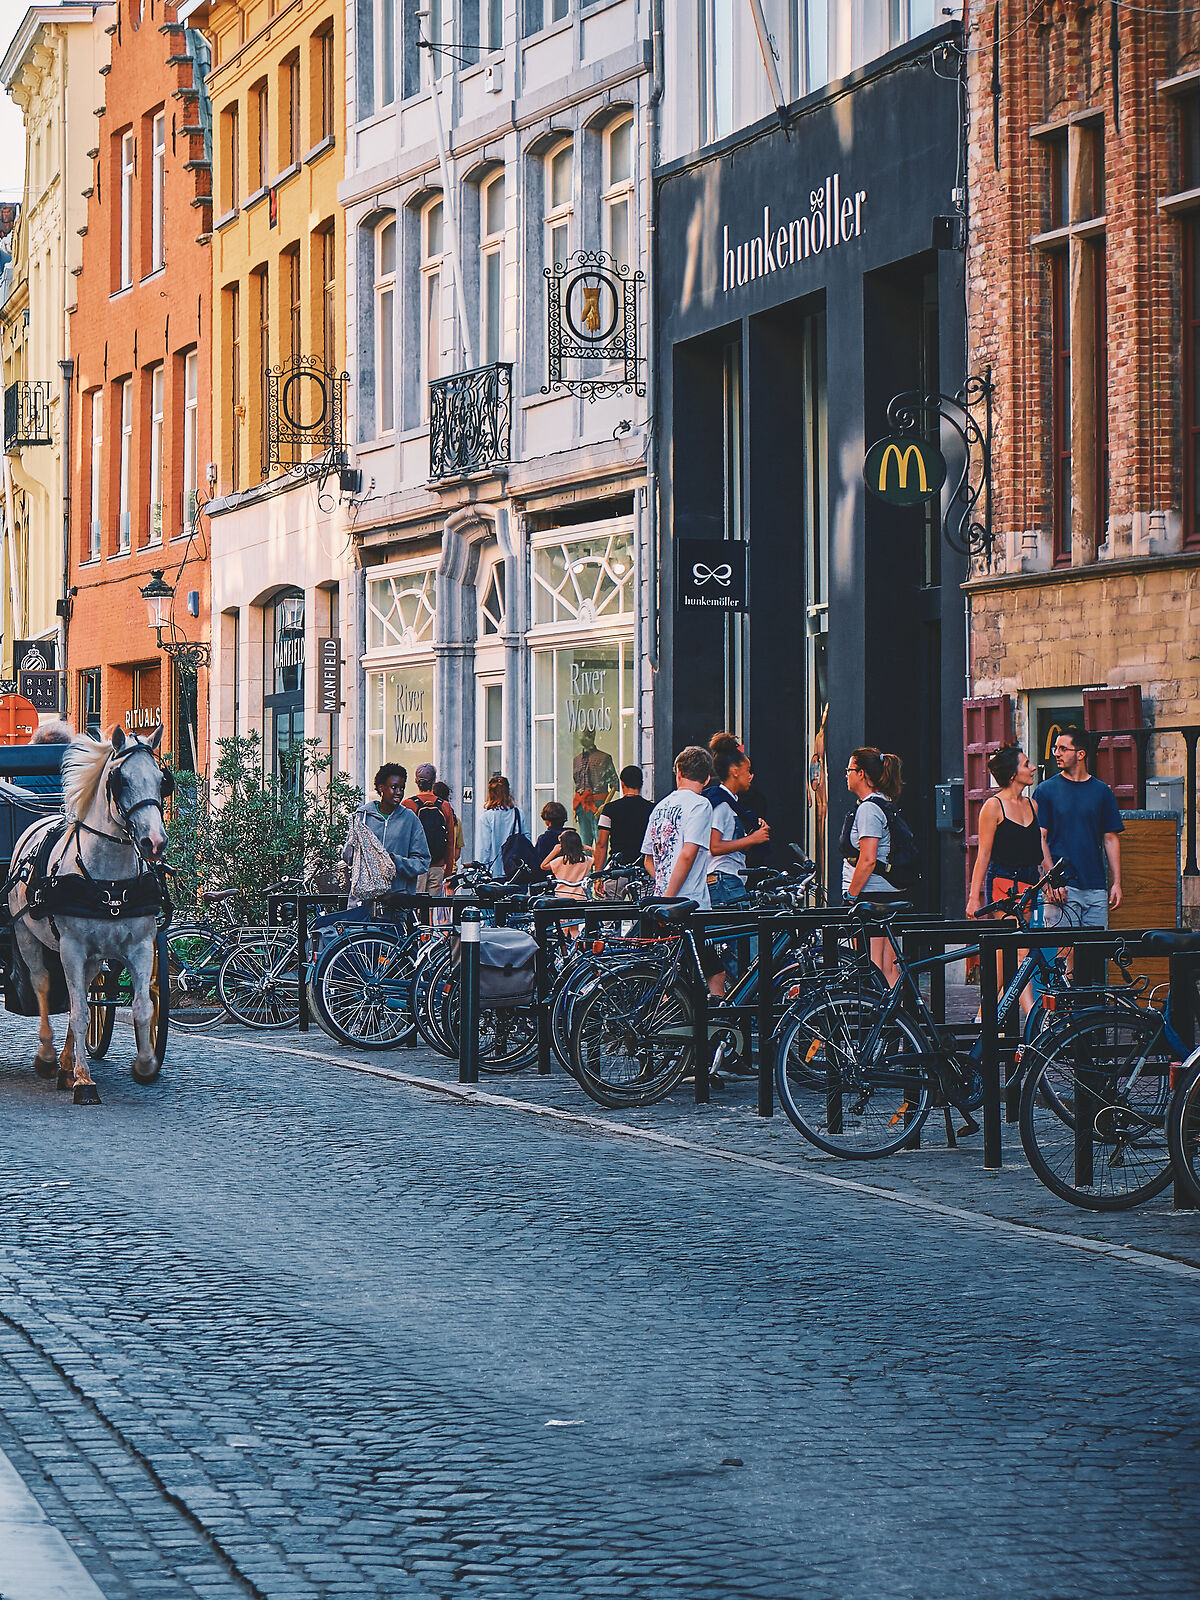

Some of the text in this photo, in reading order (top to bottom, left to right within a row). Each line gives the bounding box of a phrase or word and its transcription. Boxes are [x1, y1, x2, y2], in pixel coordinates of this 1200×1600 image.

[684, 595, 740, 607] hunkemöller
[274, 637, 305, 669] MANFIELD
[323, 640, 337, 711] MANFIELD
[569, 661, 607, 696] River
[396, 684, 425, 713] River
[125, 707, 161, 729] RITUALS
[394, 712, 429, 745] Woods
[566, 696, 613, 734] Woods
[463, 790, 473, 800] 44
[997, 988, 1020, 1024] GASUS
